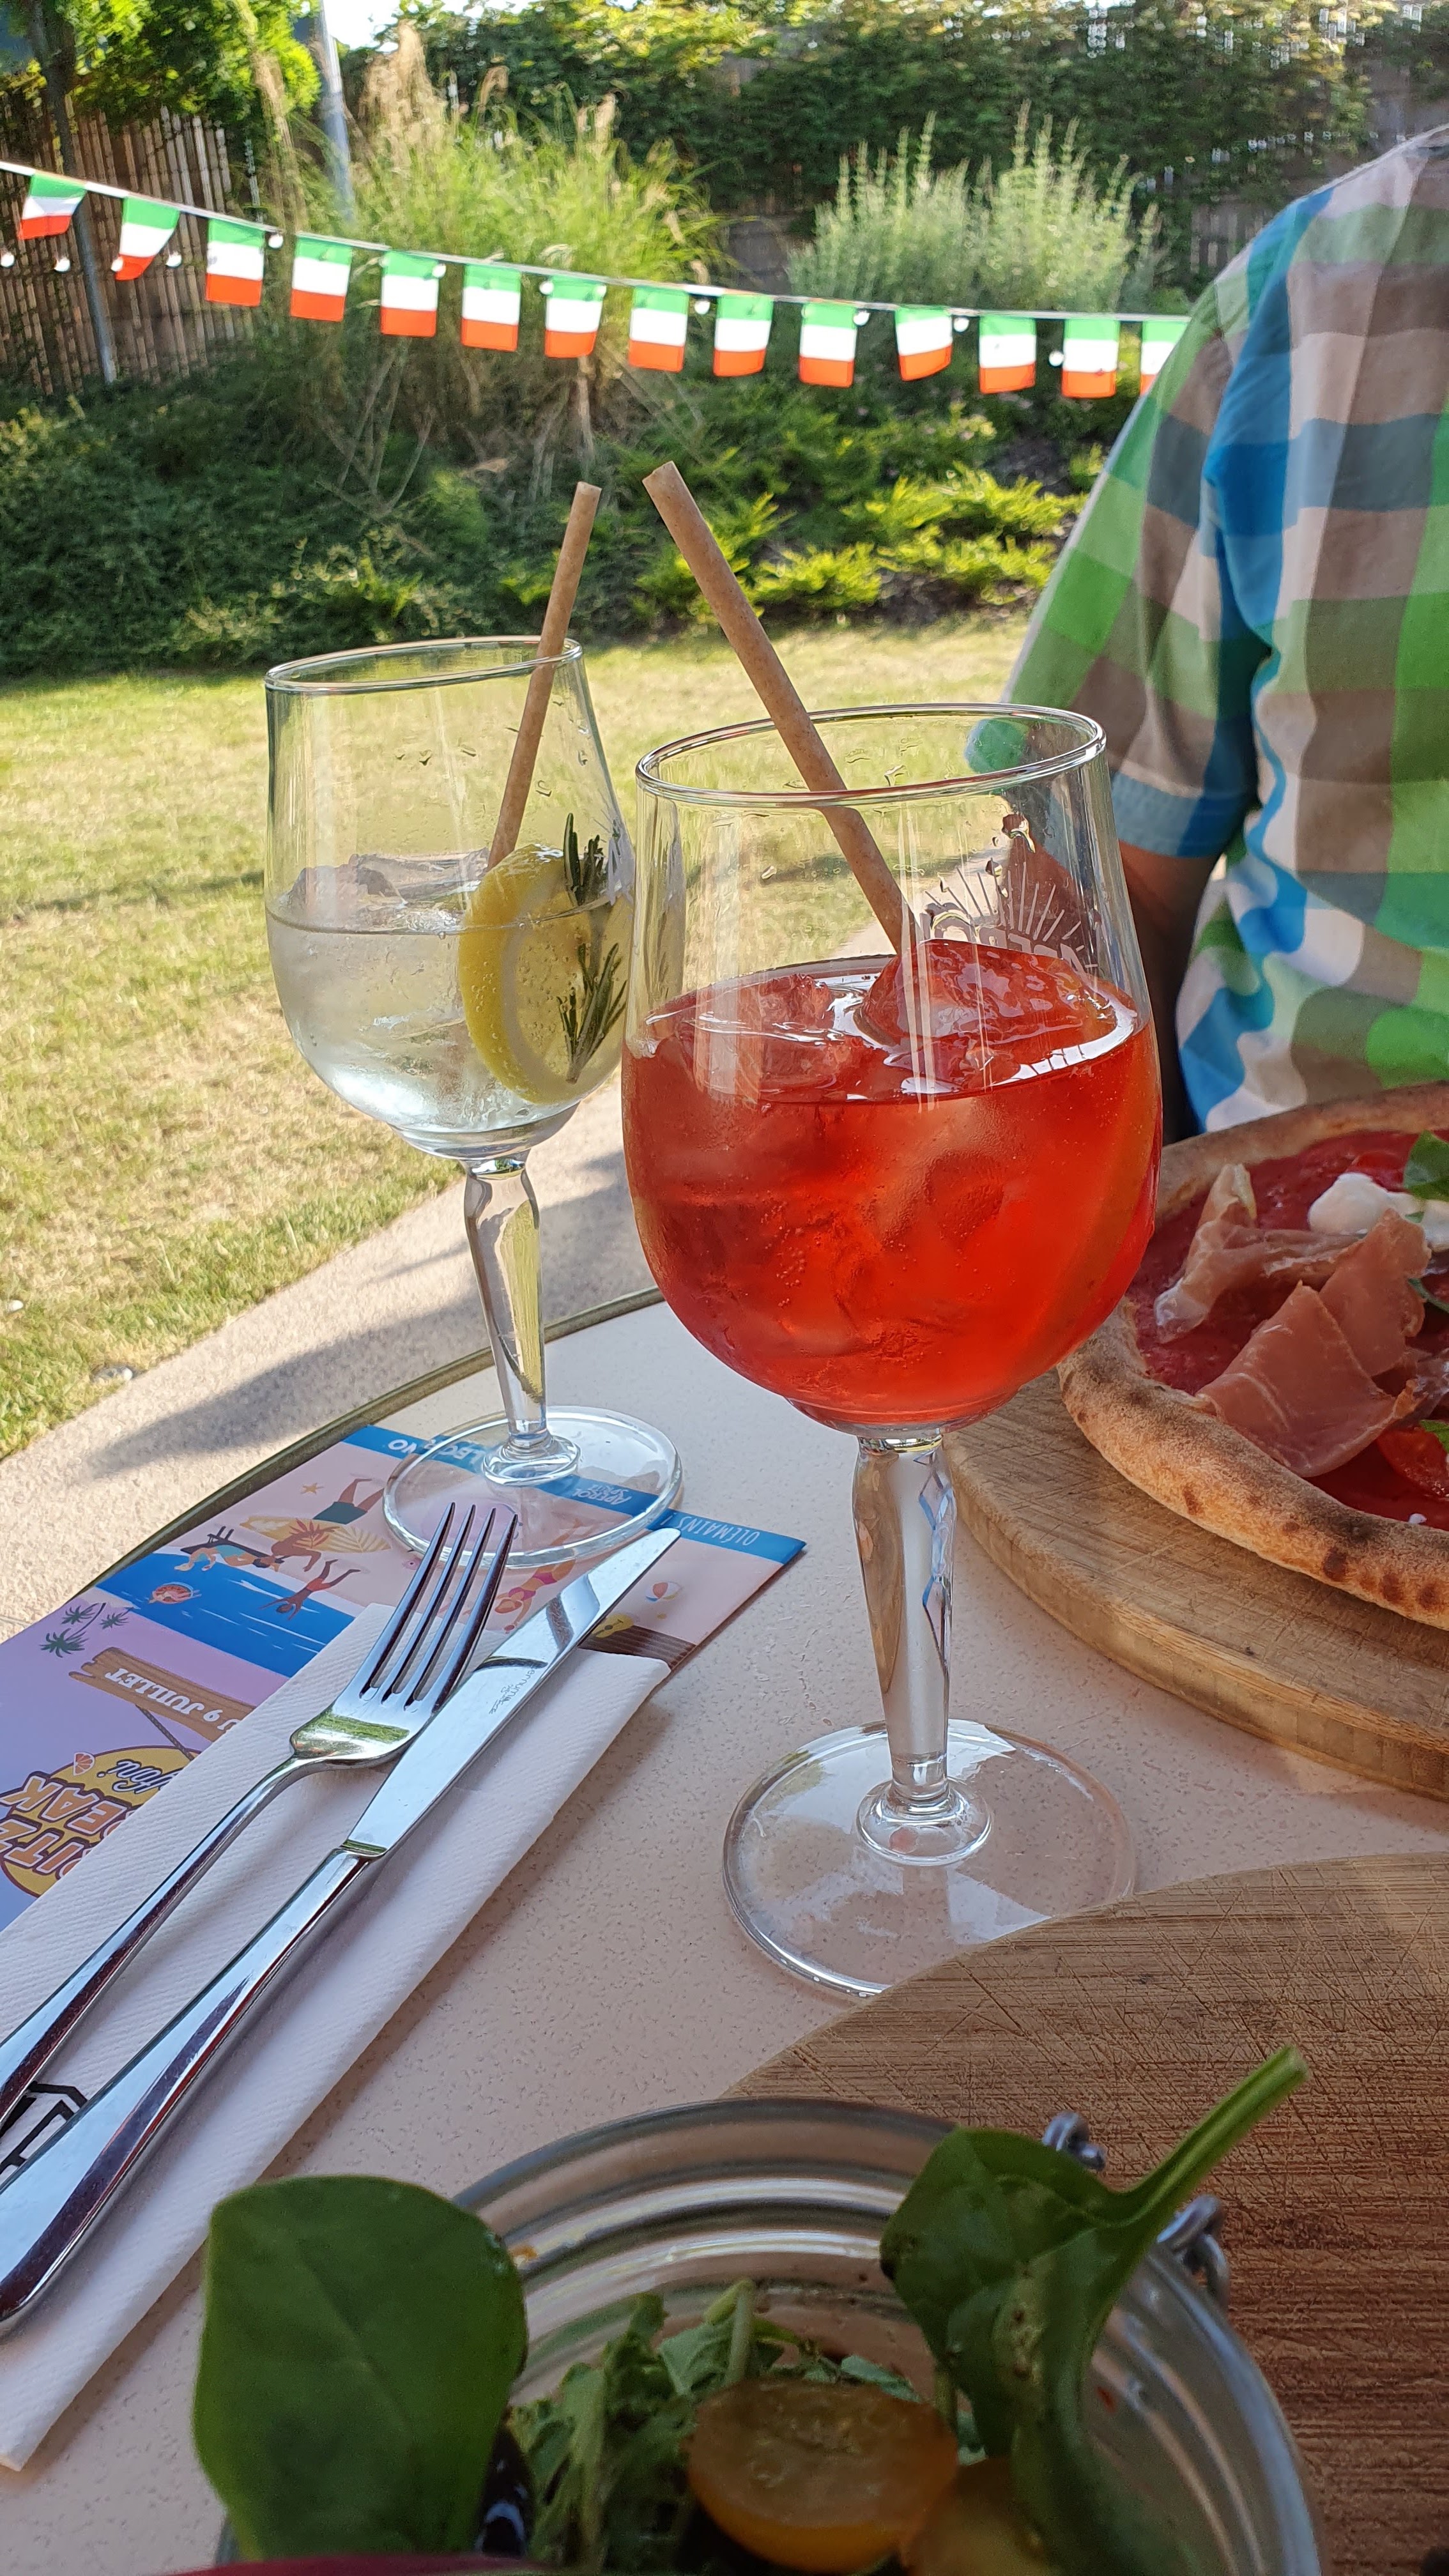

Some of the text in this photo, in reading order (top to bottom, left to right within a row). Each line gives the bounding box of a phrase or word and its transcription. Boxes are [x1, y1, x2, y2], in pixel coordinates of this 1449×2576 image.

[572, 1488, 632, 1505] APEROL
[105, 1668, 204, 1714] JUILLET
[203, 1710, 223, 1721] 9
[0, 1775, 135, 1837] EAK
